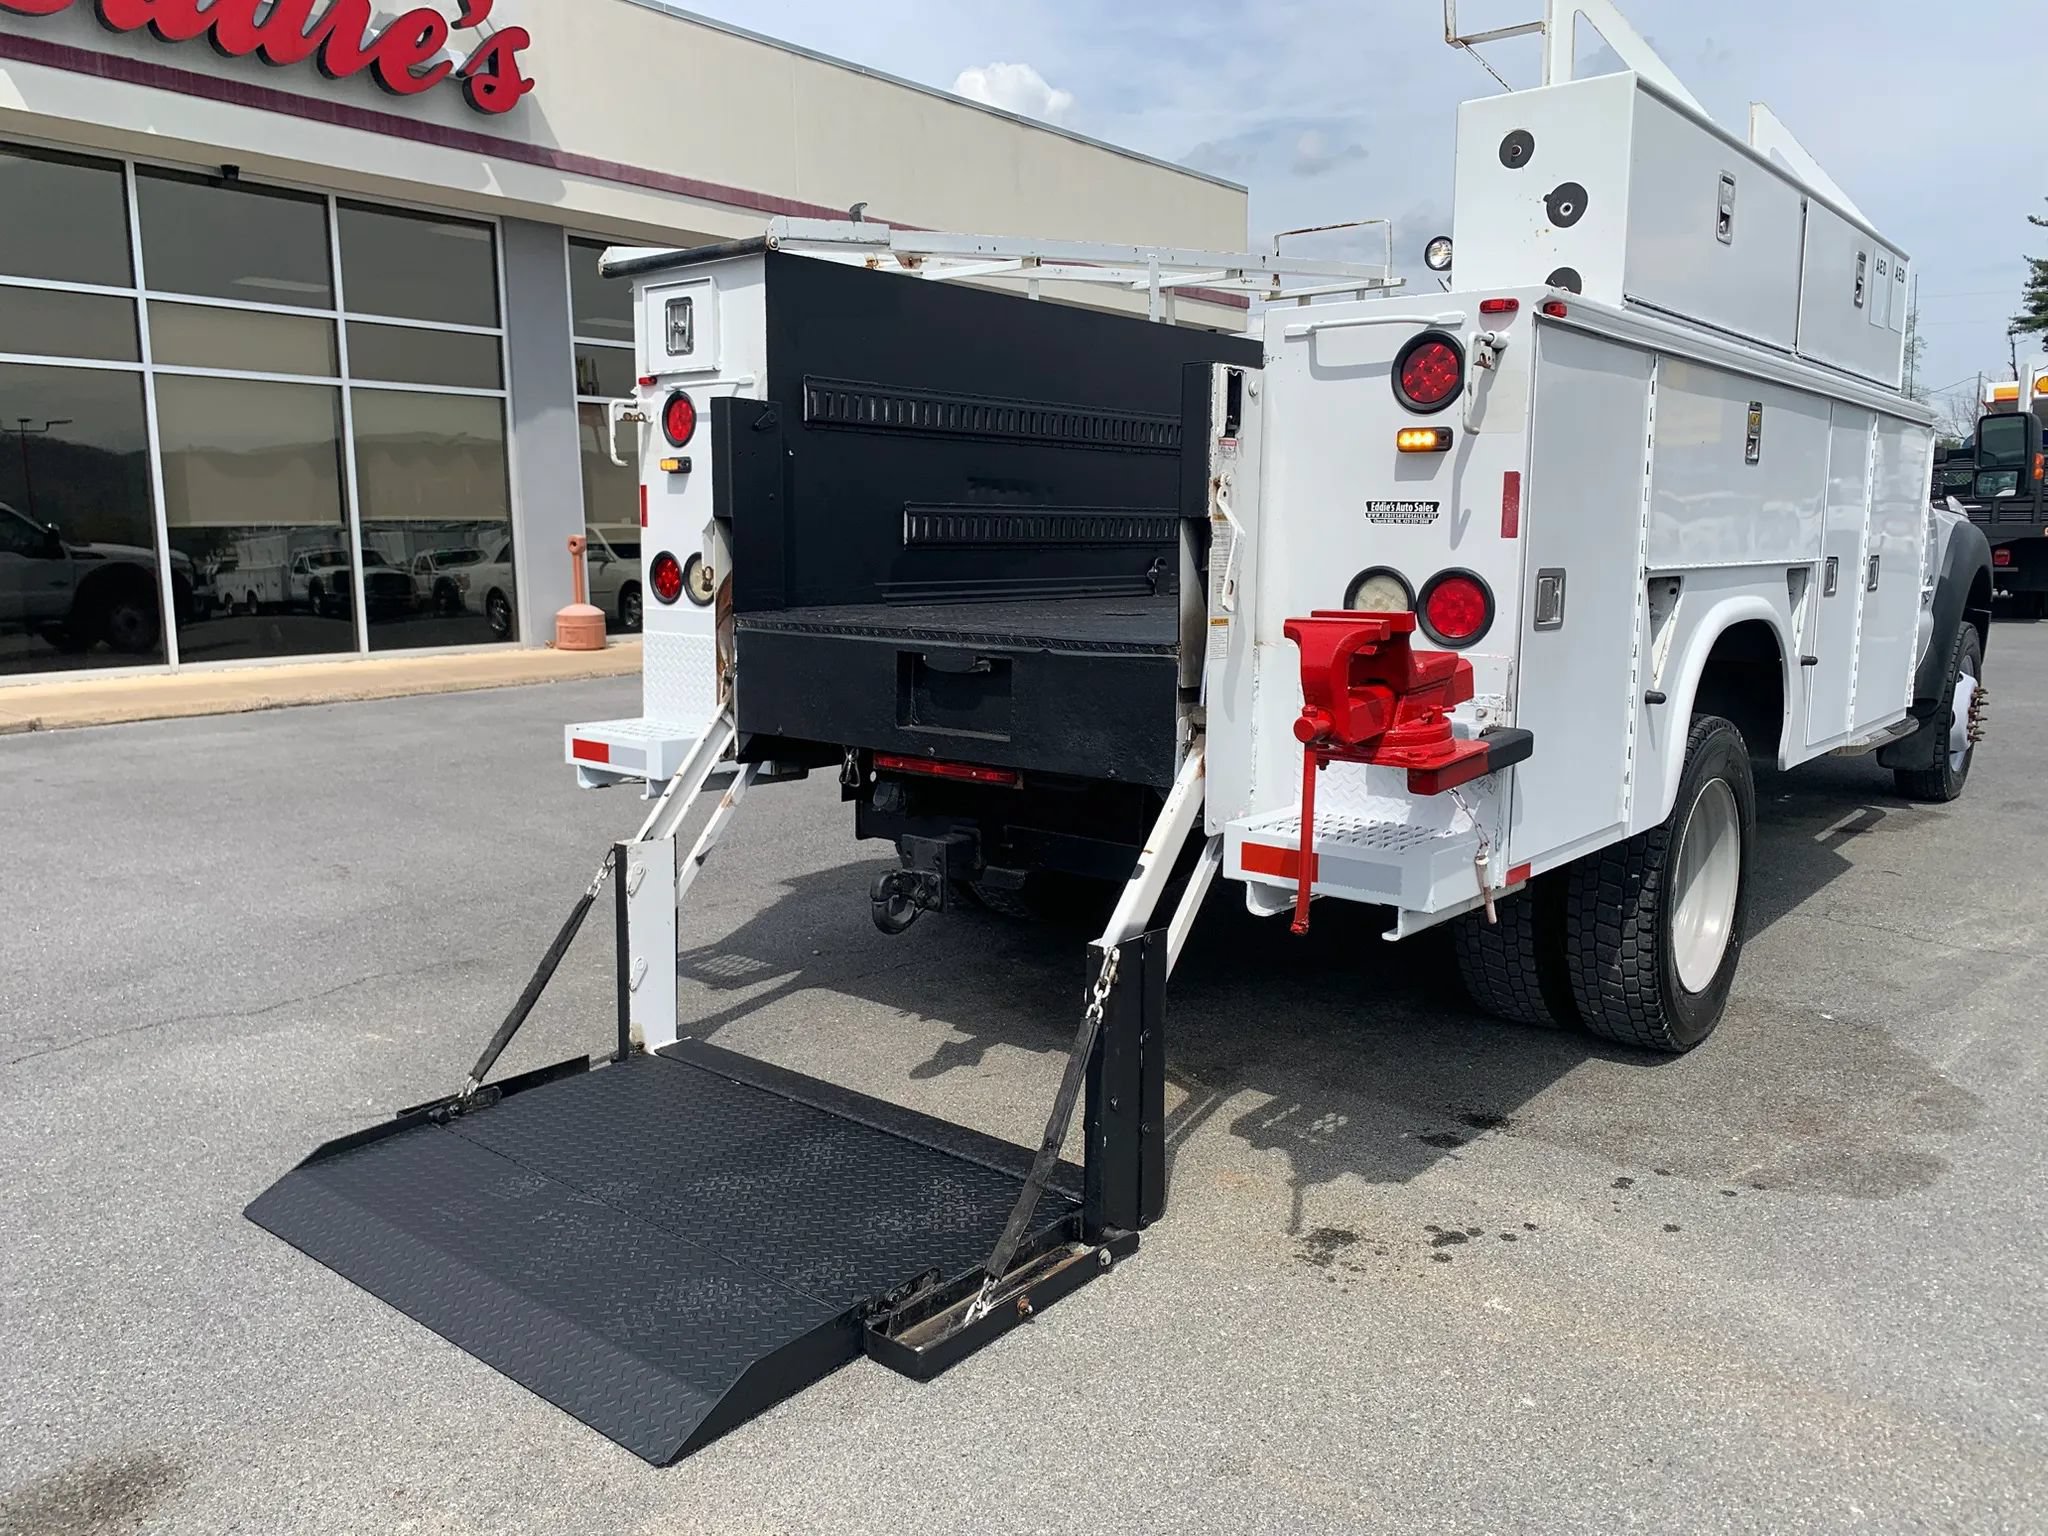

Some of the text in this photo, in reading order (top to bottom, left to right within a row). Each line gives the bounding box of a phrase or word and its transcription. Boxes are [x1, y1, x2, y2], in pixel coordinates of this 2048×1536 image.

[1371, 502, 1434, 512] Eddie's Auto Sales
